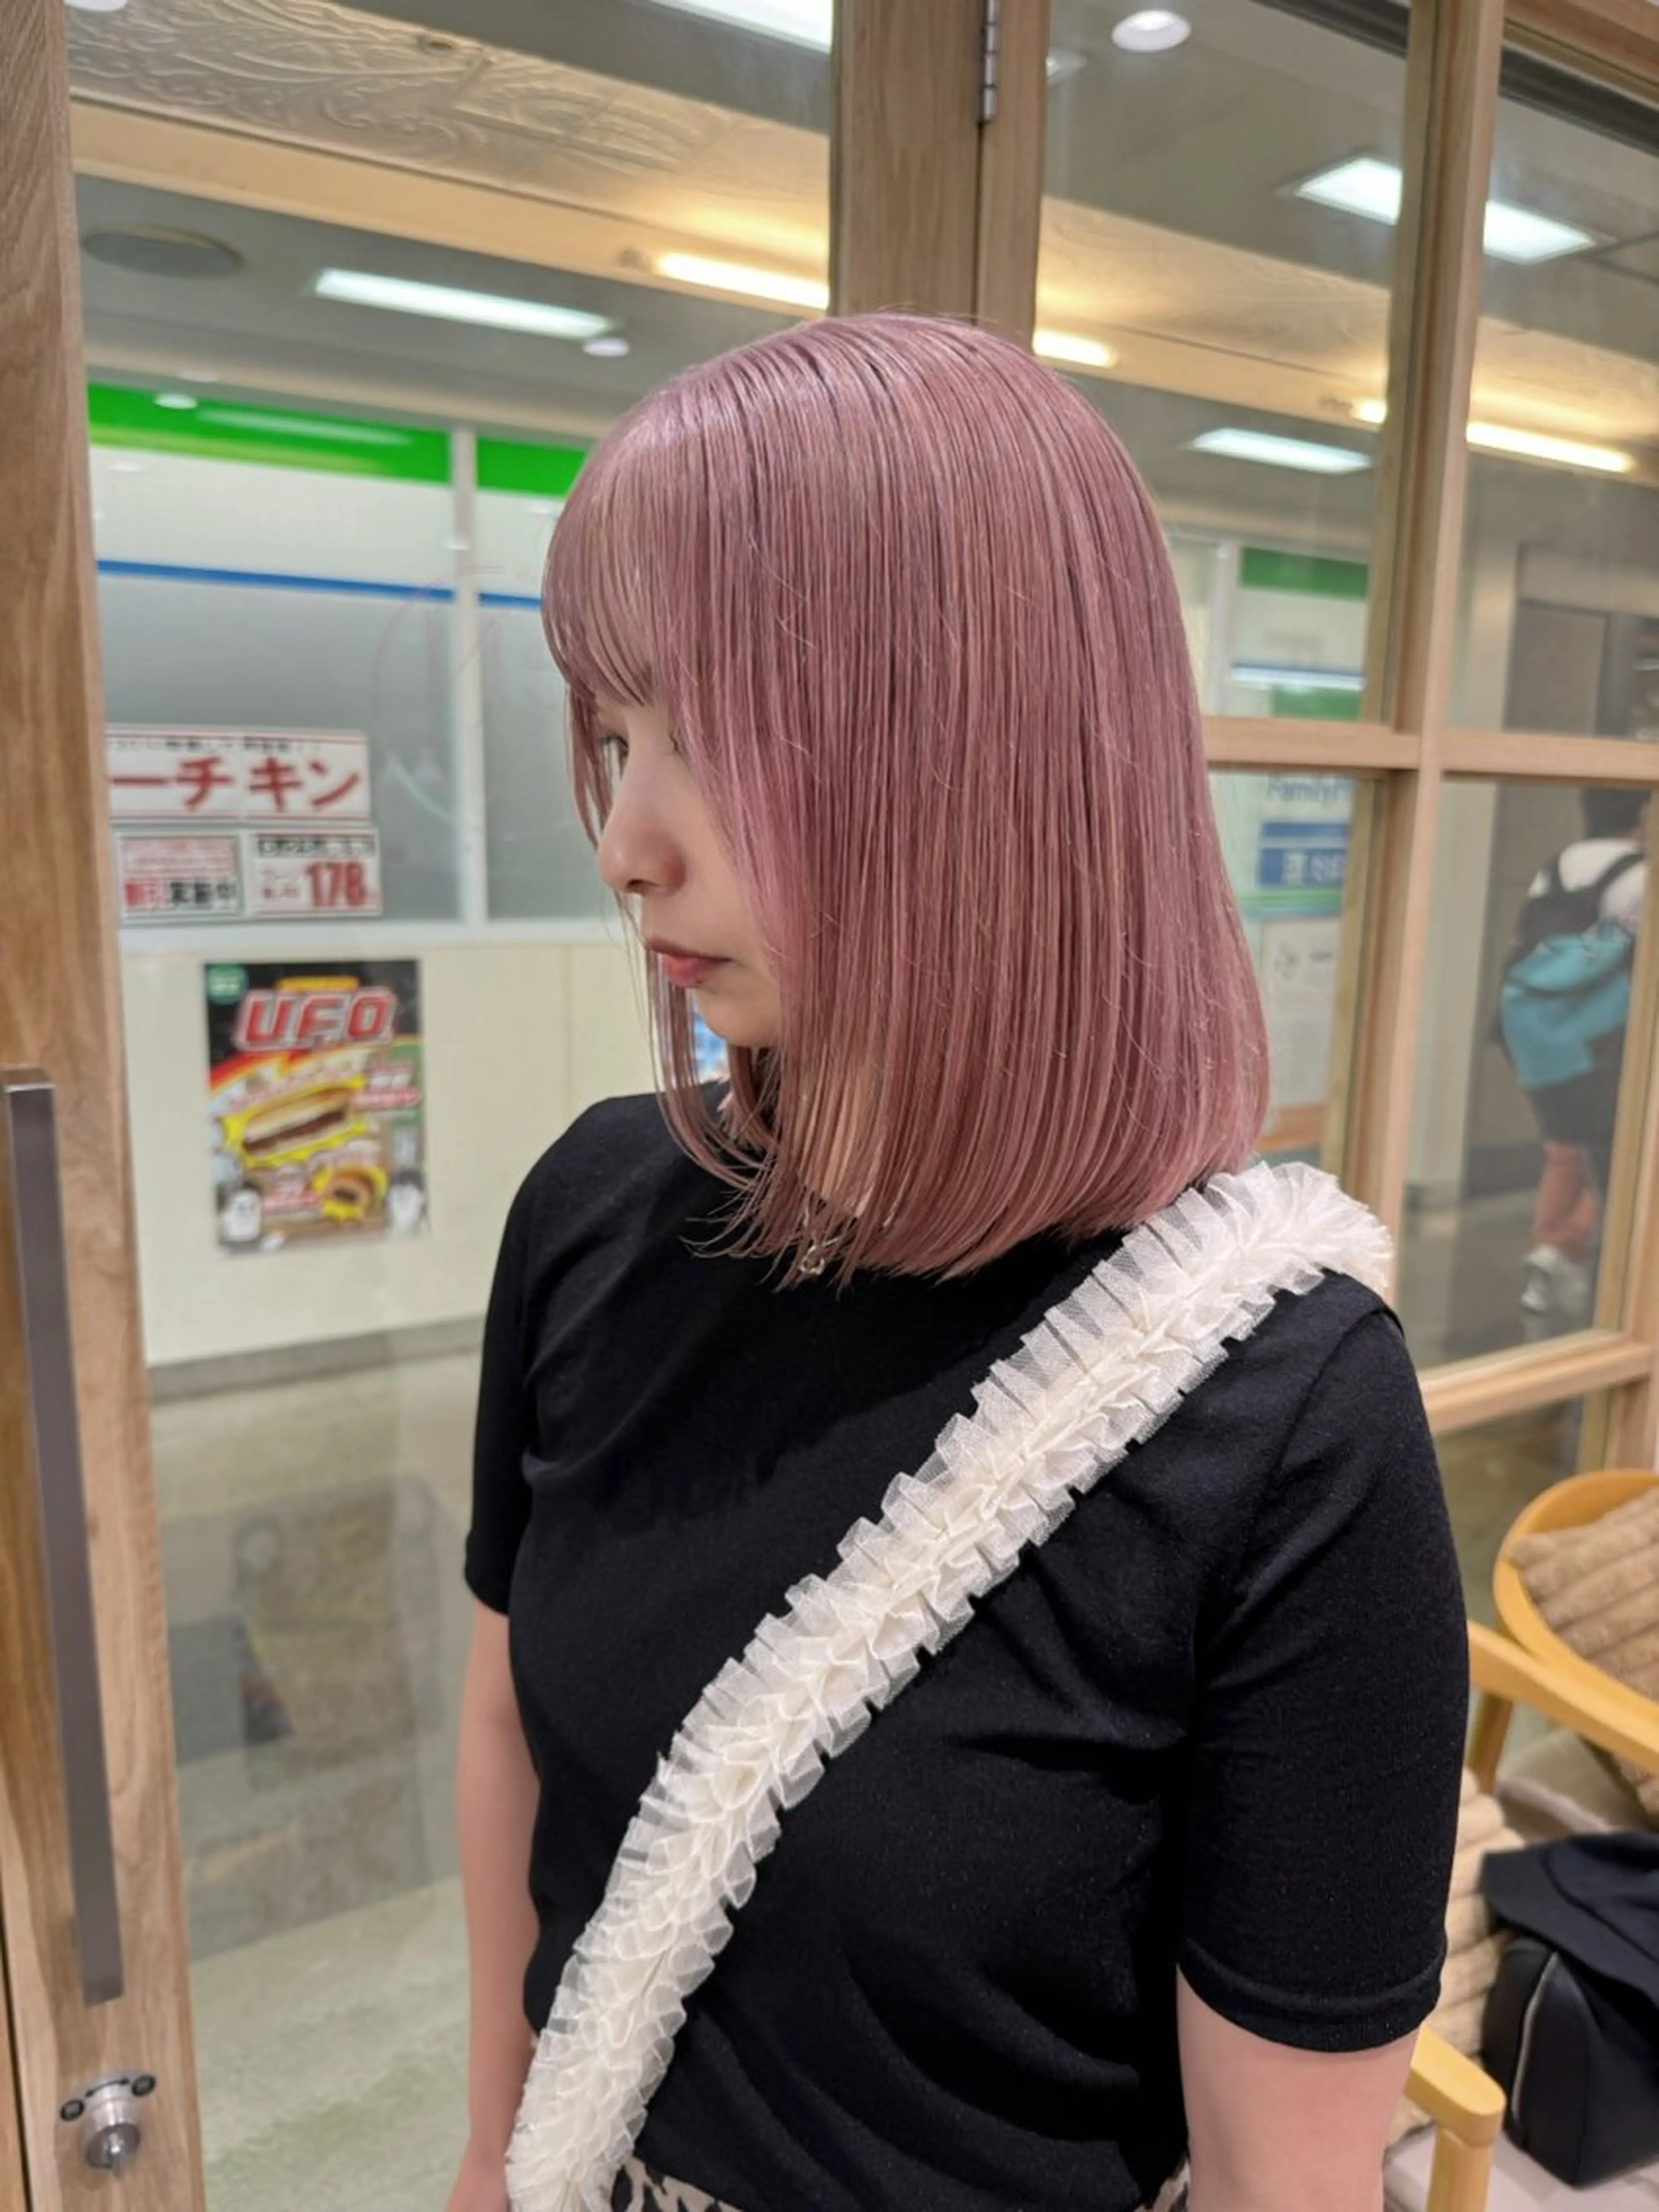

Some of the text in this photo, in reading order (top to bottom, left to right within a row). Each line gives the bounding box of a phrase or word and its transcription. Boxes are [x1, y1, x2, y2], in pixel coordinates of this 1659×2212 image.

[111, 756, 362, 813] ーチキン
[239, 989, 392, 1046] UFO
